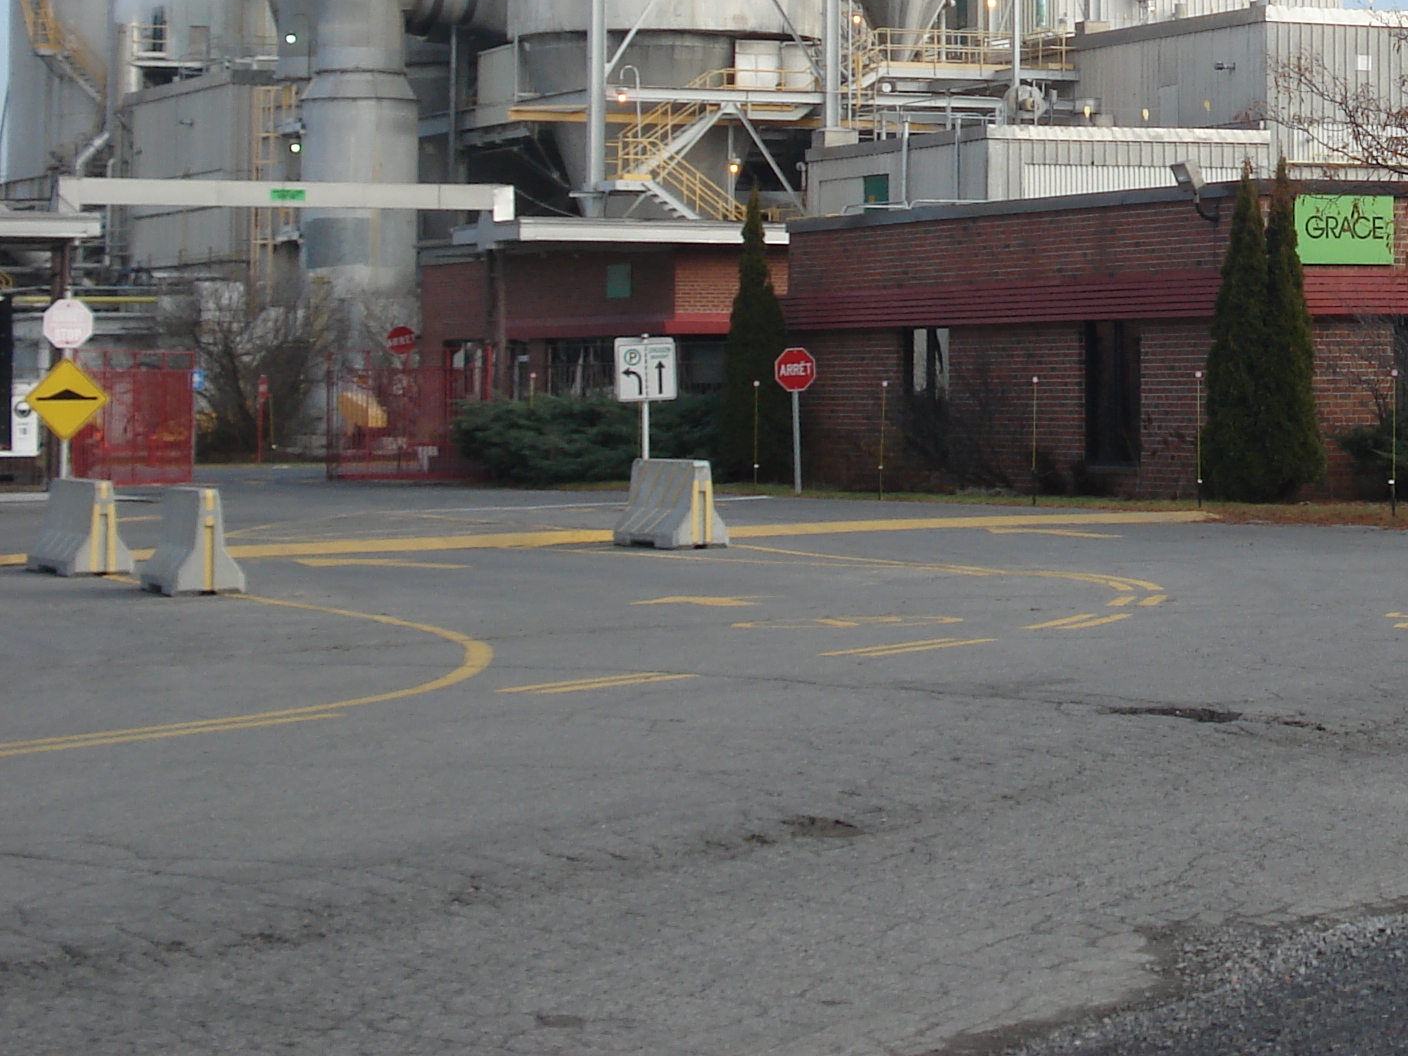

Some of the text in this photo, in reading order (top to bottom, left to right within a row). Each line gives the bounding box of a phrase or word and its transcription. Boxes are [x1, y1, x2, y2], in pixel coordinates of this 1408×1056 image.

[1305, 215, 1384, 239] GRACE
[54, 328, 83, 340] STOP
[780, 360, 811, 376] ARRÊT
